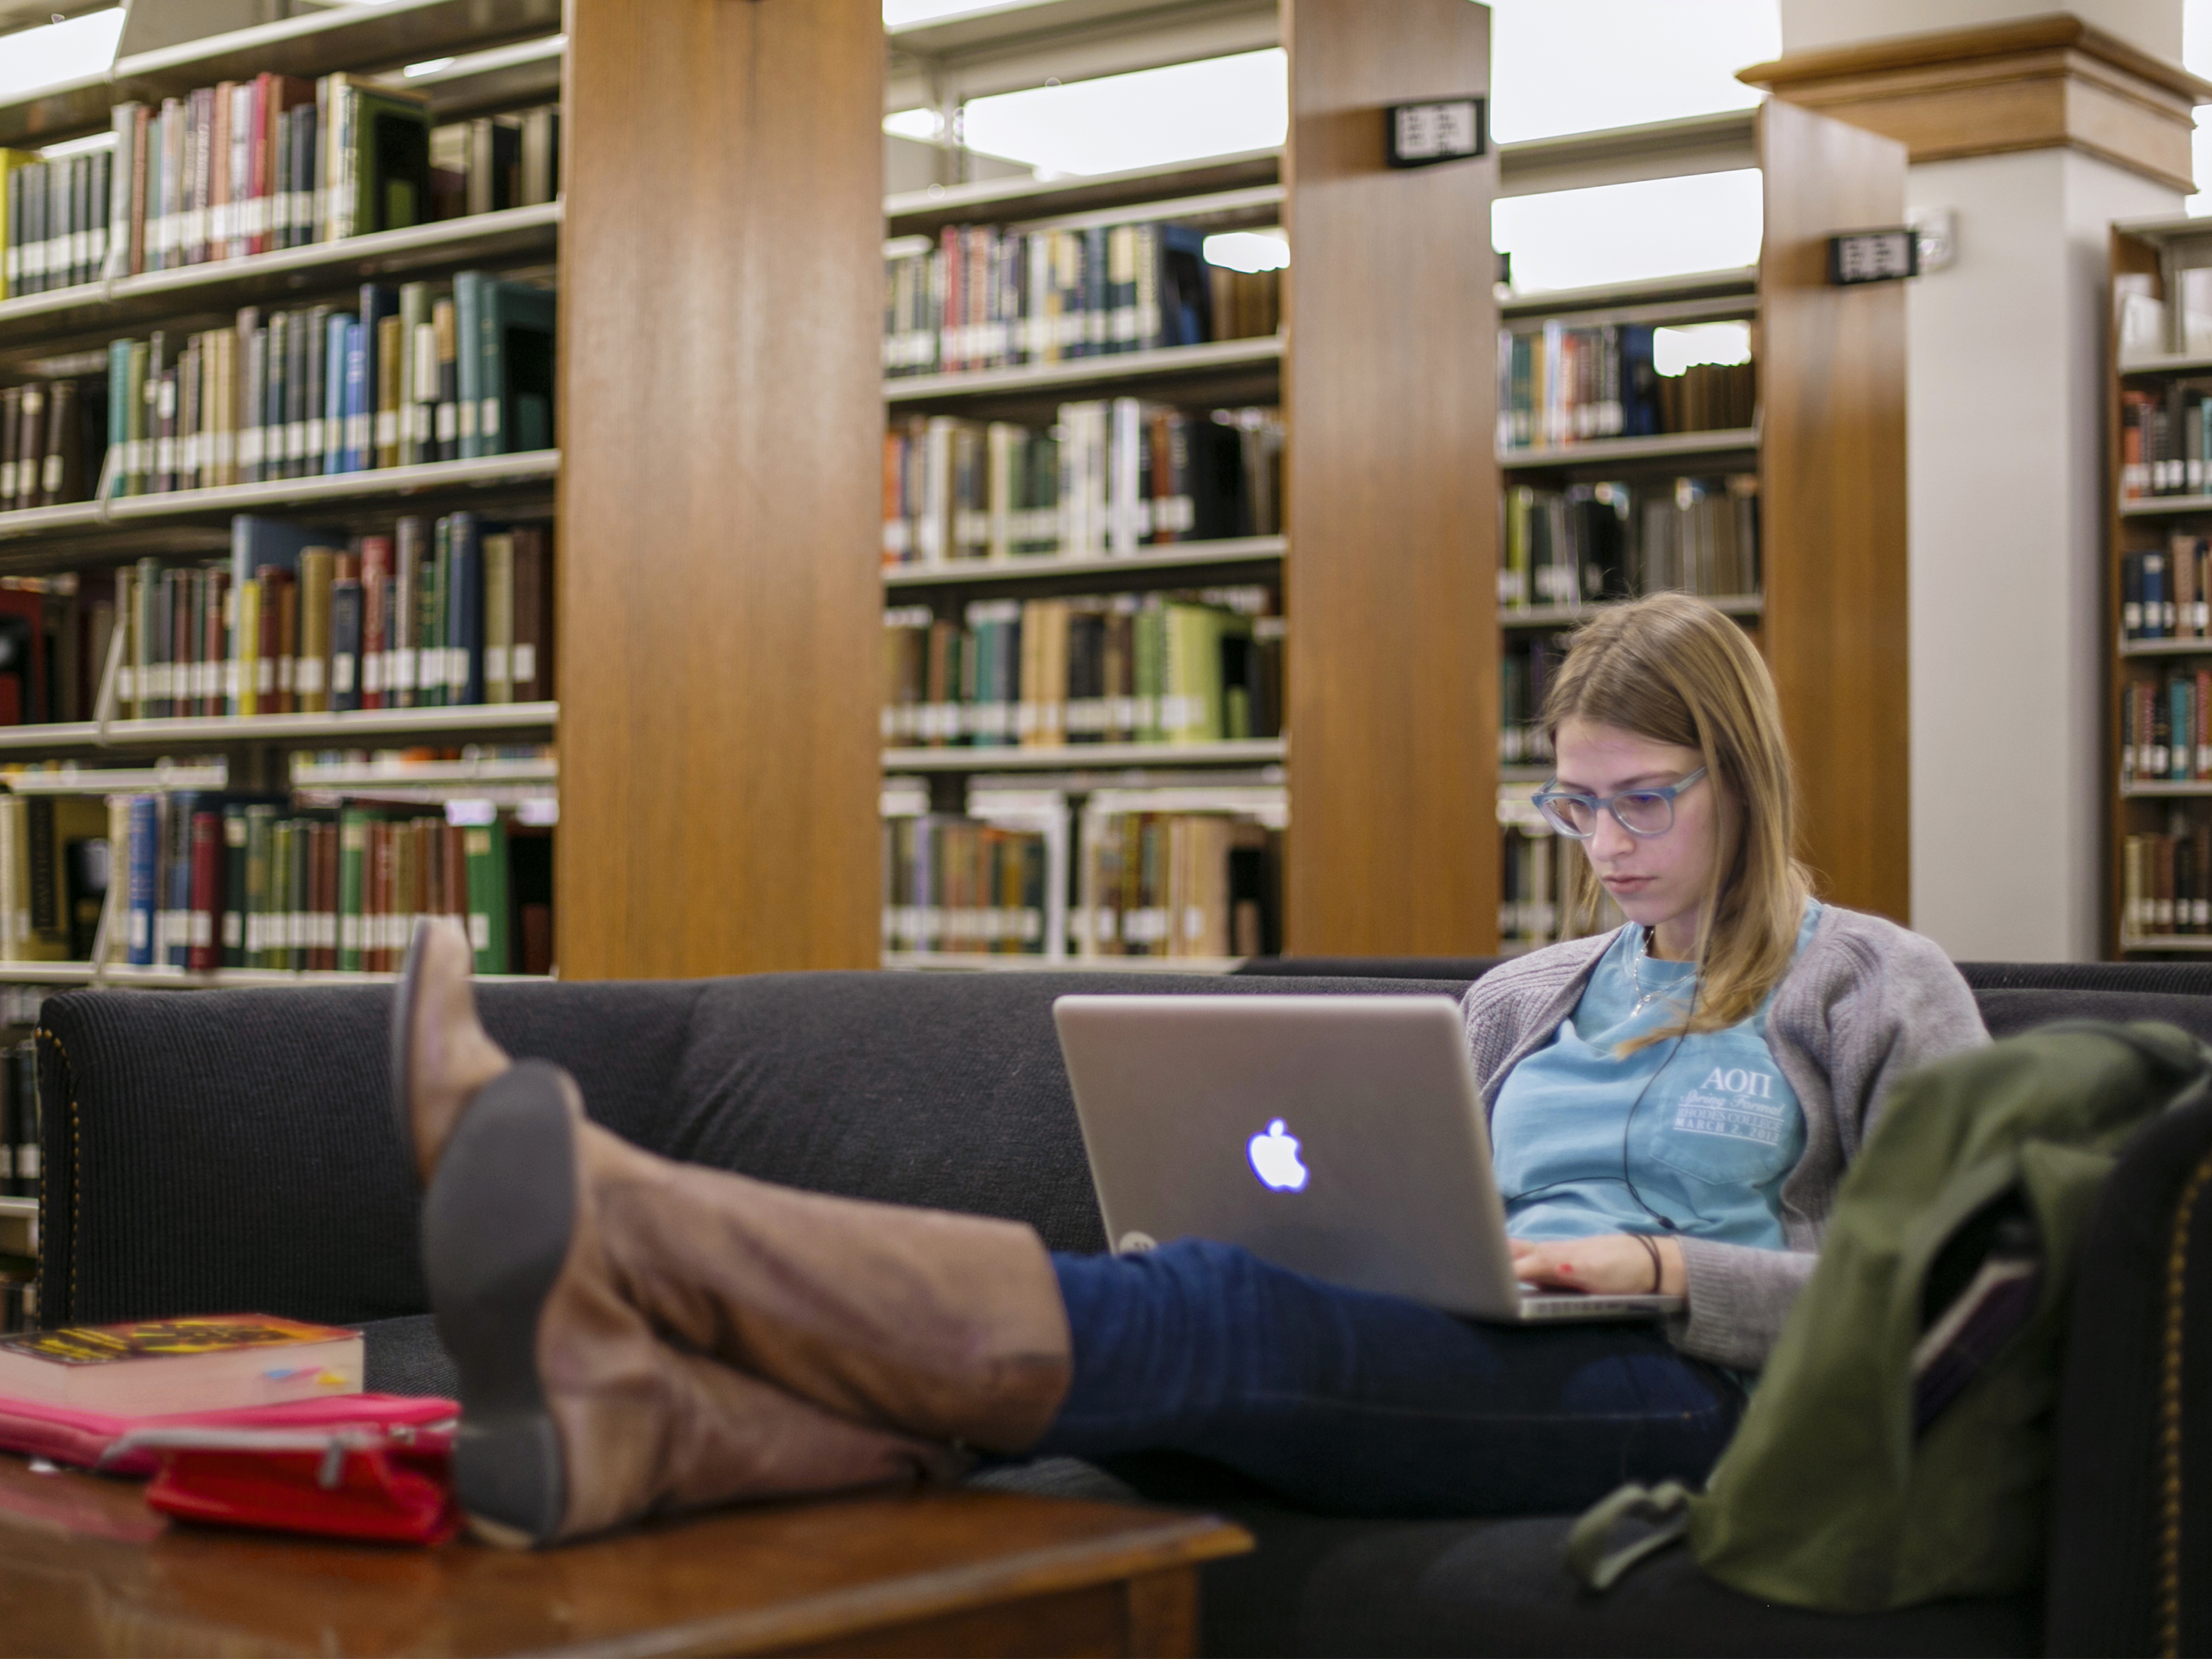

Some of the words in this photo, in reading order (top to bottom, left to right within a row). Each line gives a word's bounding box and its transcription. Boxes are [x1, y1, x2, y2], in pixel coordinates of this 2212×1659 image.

[1680, 1089, 1727, 1109] Spring
[1730, 1094, 1786, 1116] Formal
[1674, 1118, 1725, 1132] MARCH
[1750, 1128, 1780, 1142] 2013
[1677, 1108, 1727, 1121] RHODES
[1728, 1113, 1783, 1133] COLLEGE
